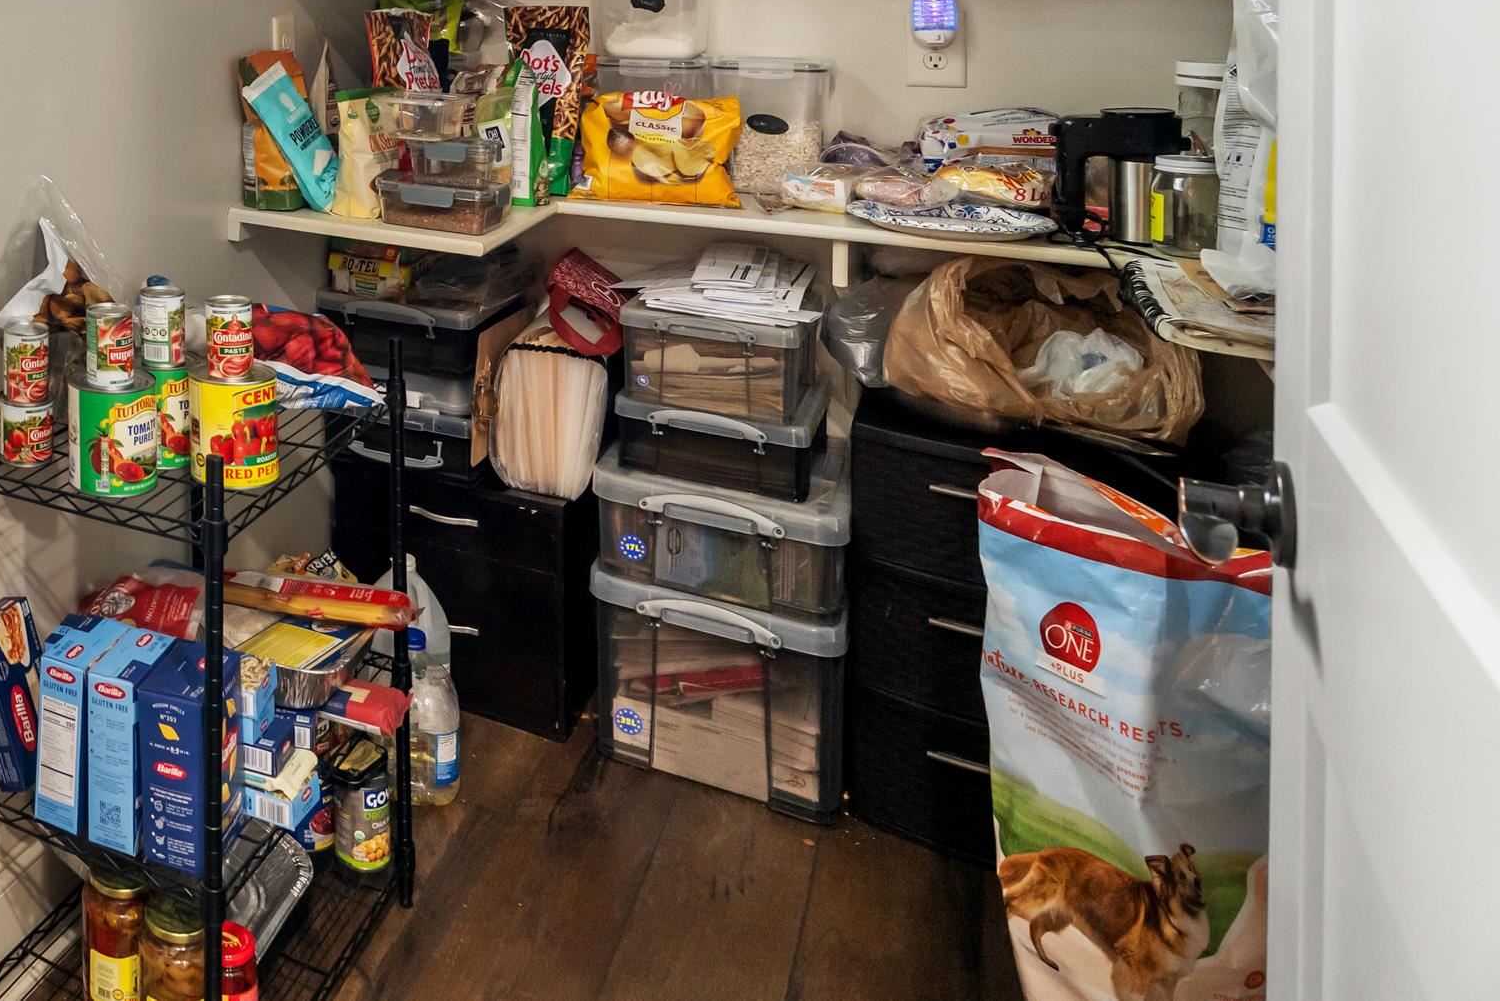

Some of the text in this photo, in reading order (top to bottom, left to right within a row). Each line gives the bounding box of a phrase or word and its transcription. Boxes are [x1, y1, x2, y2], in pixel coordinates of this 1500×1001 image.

[536, 80, 563, 97] zels
[635, 121, 677, 133] CLASSIC
[1014, 188, 1026, 202] 8
[242, 386, 276, 405] CENT
[134, 430, 154, 446] PUREE
[225, 468, 253, 479] RED
[625, 542, 641, 552] 17L
[1073, 624, 1093, 638] PURINA
[1045, 624, 1094, 664] ONE
[49, 667, 75, 683] Barilla
[43, 680, 78, 698] GLUTEN FREE
[97, 684, 123, 699] Barilla
[91, 696, 129, 713] GLUTEN FREE
[1033, 679, 1115, 730] RESEARCH.
[11, 691, 35, 743] Barilla
[157, 763, 184, 778] Barilla
[366, 788, 390, 808] GO
